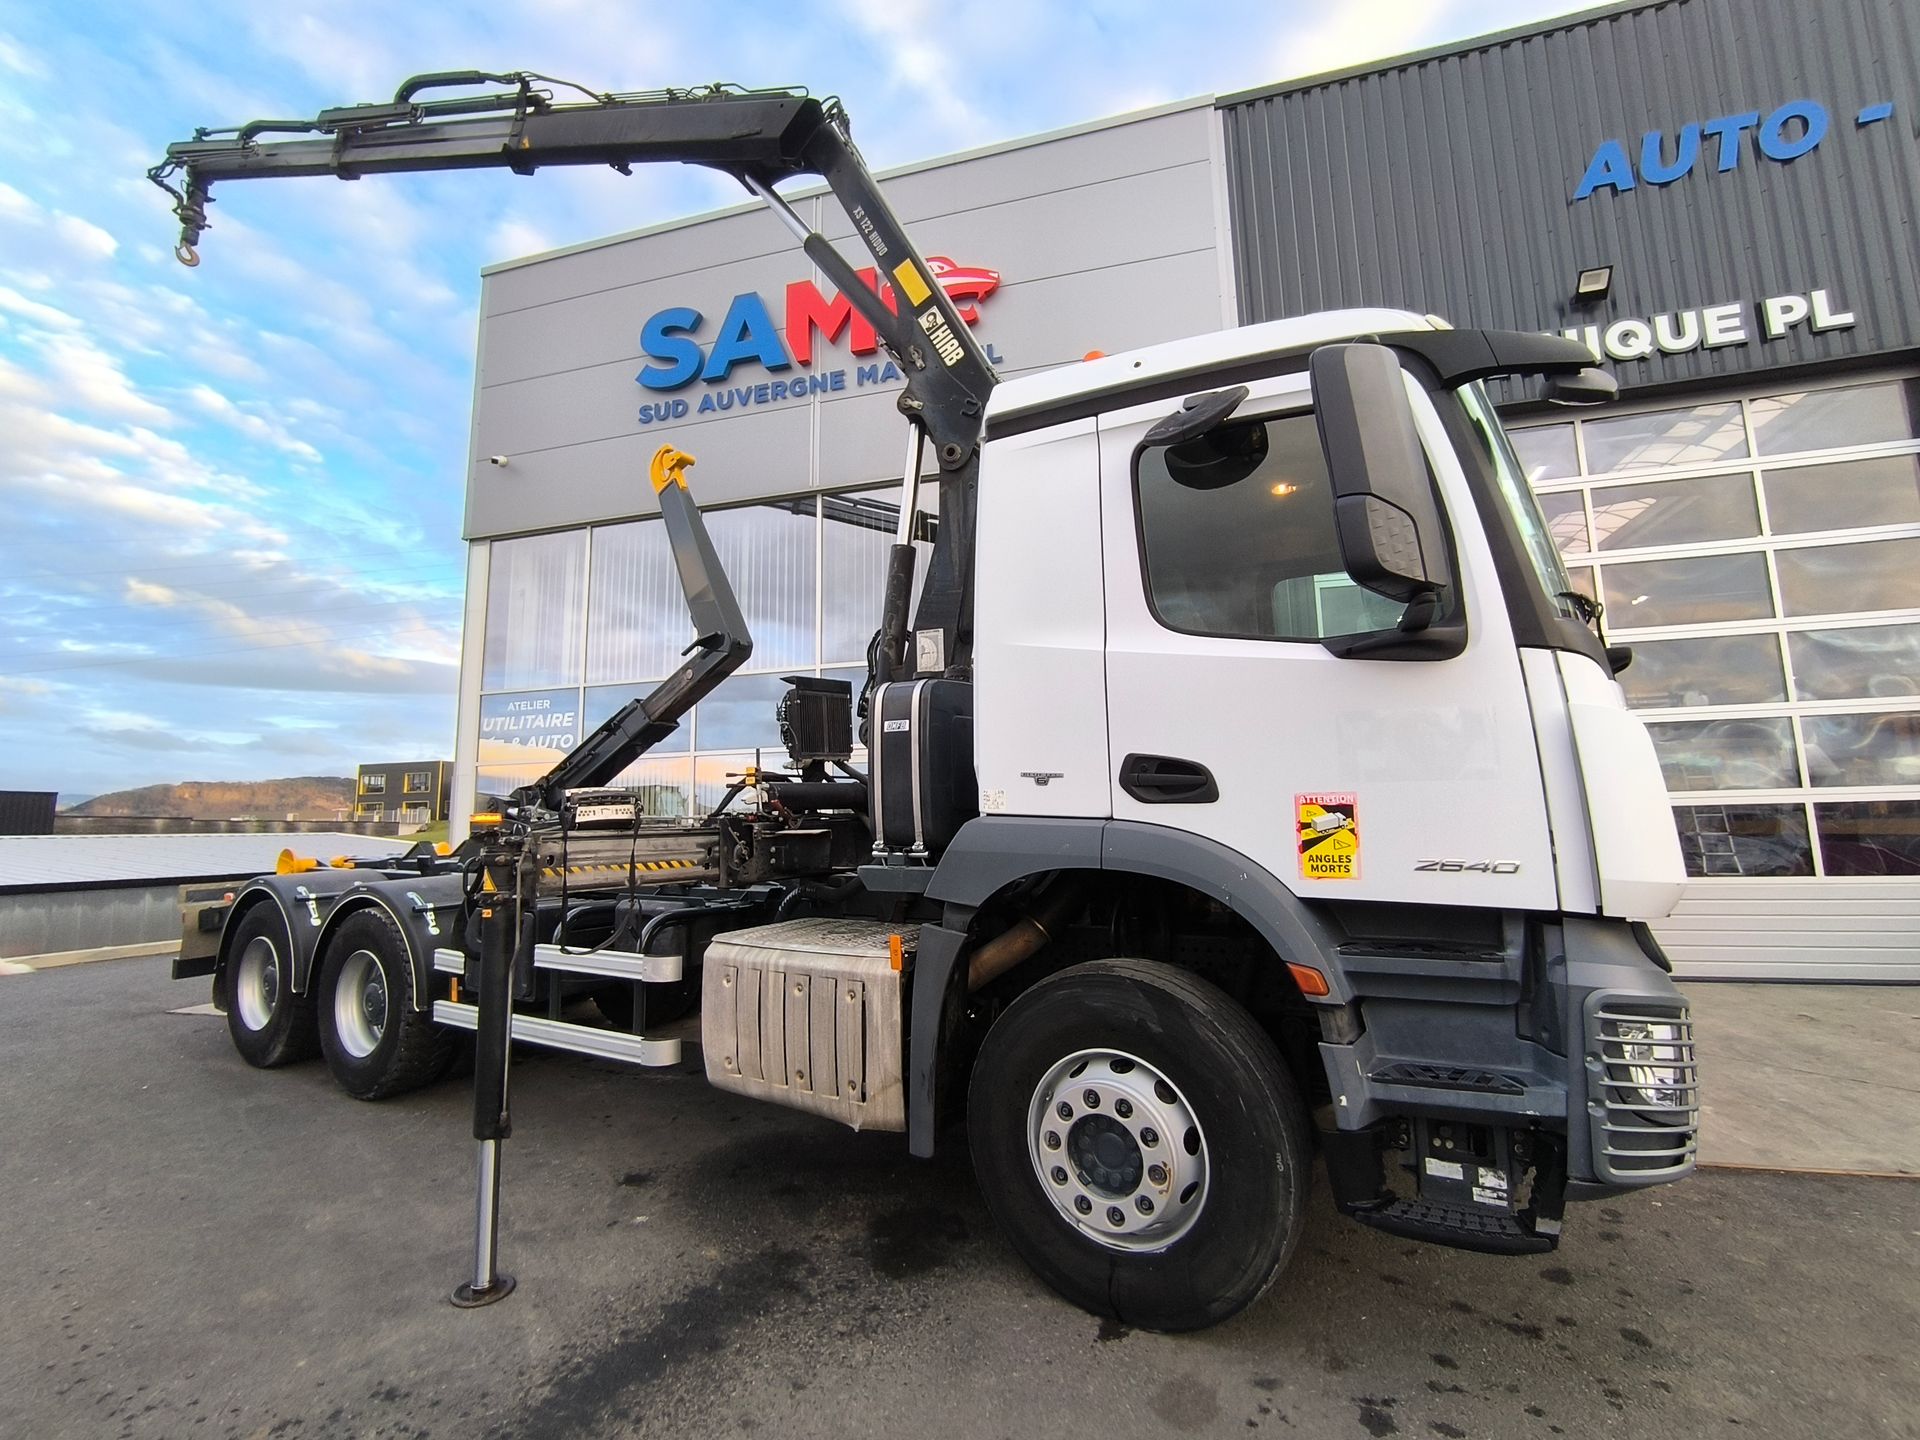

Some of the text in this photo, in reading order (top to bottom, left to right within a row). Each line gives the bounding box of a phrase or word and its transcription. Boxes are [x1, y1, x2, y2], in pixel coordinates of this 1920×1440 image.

[1573, 99, 1830, 200] AUTO
[852, 205, 888, 257] XS 122 HIDUO
[1764, 289, 1856, 340] PL
[929, 323, 965, 367] HIAB
[637, 369, 845, 424] SUD AUVERGNE
[507, 699, 551, 711] ATELIER
[482, 712, 575, 732] UTILITAIRE
[526, 733, 574, 749] AUTO
[1298, 795, 1355, 804] ATTENTION
[1308, 854, 1352, 864] ANGLES
[1414, 858, 1521, 874] 2640
[1310, 864, 1351, 873] MORTS
